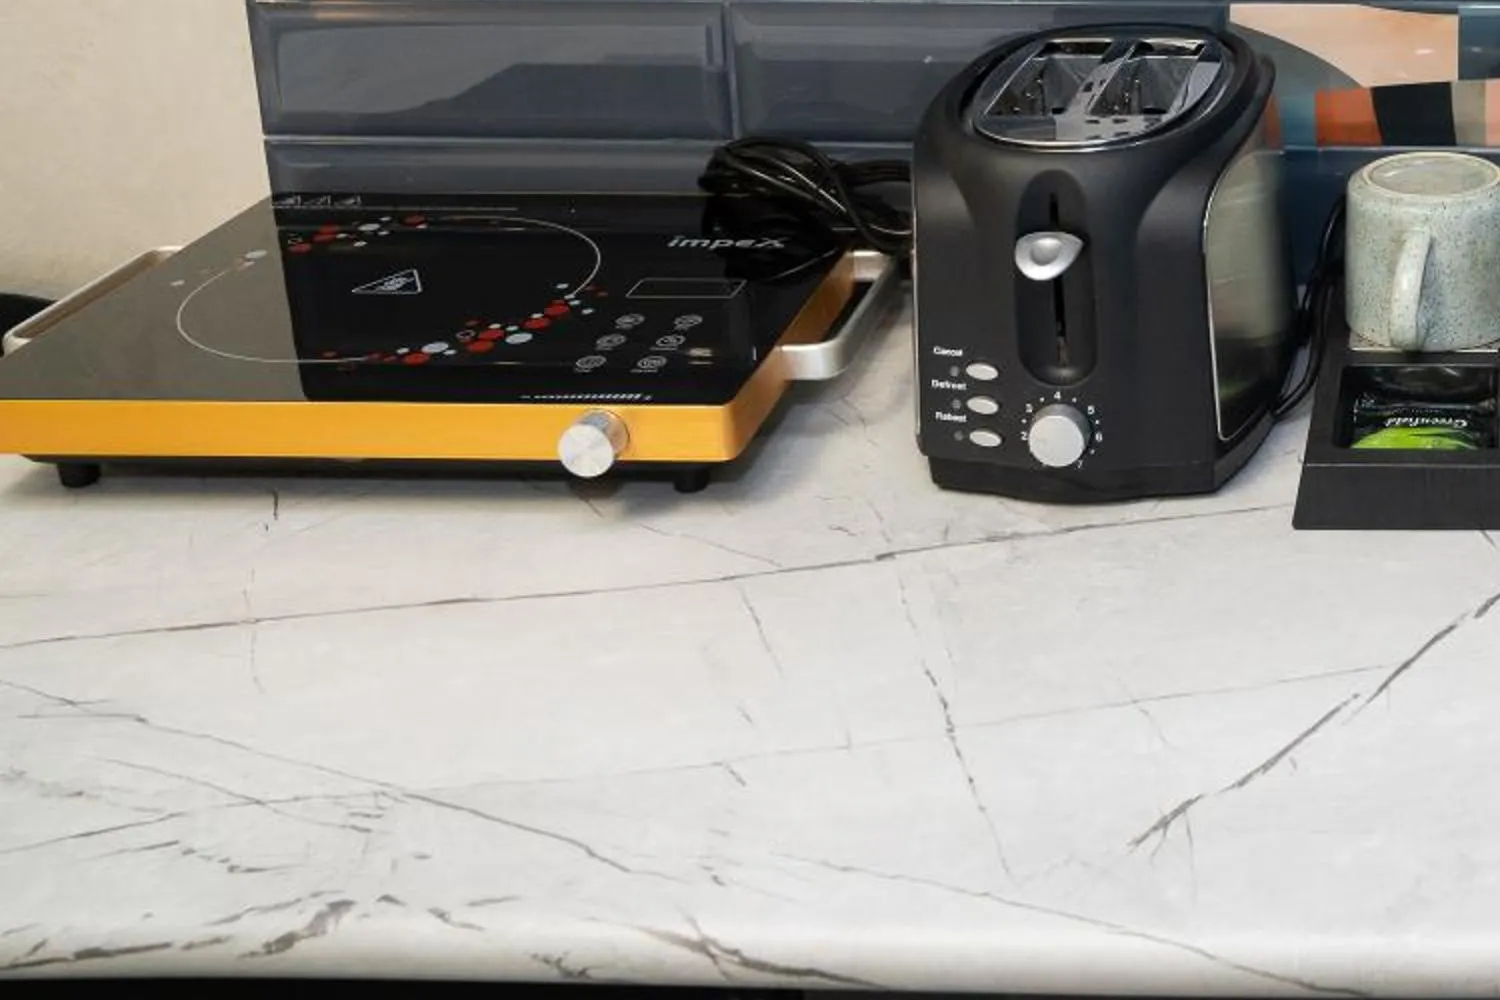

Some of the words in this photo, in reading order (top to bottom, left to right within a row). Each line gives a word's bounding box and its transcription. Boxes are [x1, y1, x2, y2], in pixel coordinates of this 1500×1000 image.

[1053, 391, 1061, 400] 4
[1087, 405, 1095, 415] 5
[1021, 431, 1028, 441] 2
